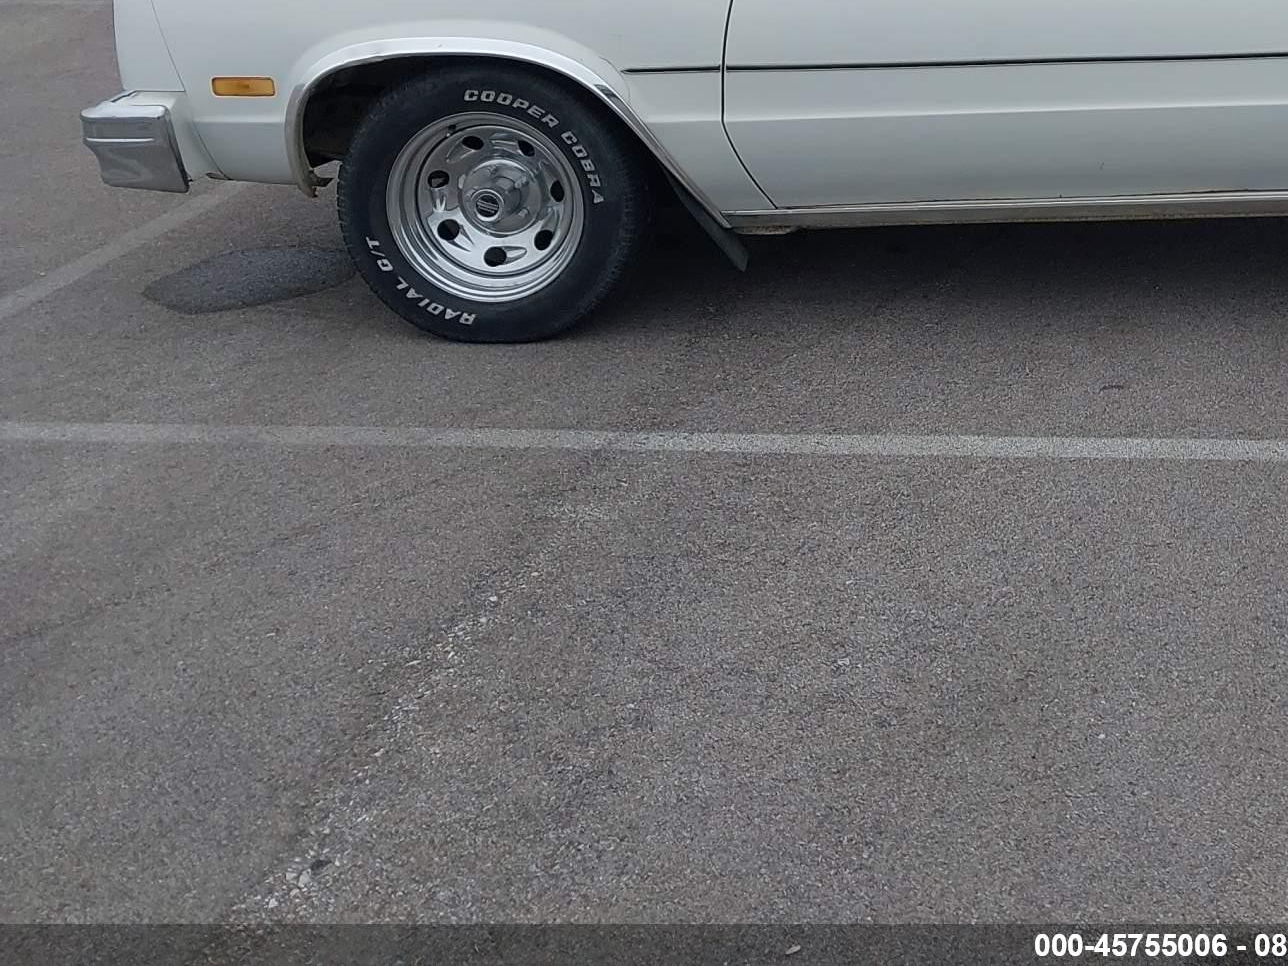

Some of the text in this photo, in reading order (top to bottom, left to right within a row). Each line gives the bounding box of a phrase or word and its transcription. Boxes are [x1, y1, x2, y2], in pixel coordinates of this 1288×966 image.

[464, 89, 604, 204] COOPER COBRA
[396, 276, 476, 325] RADIAL
